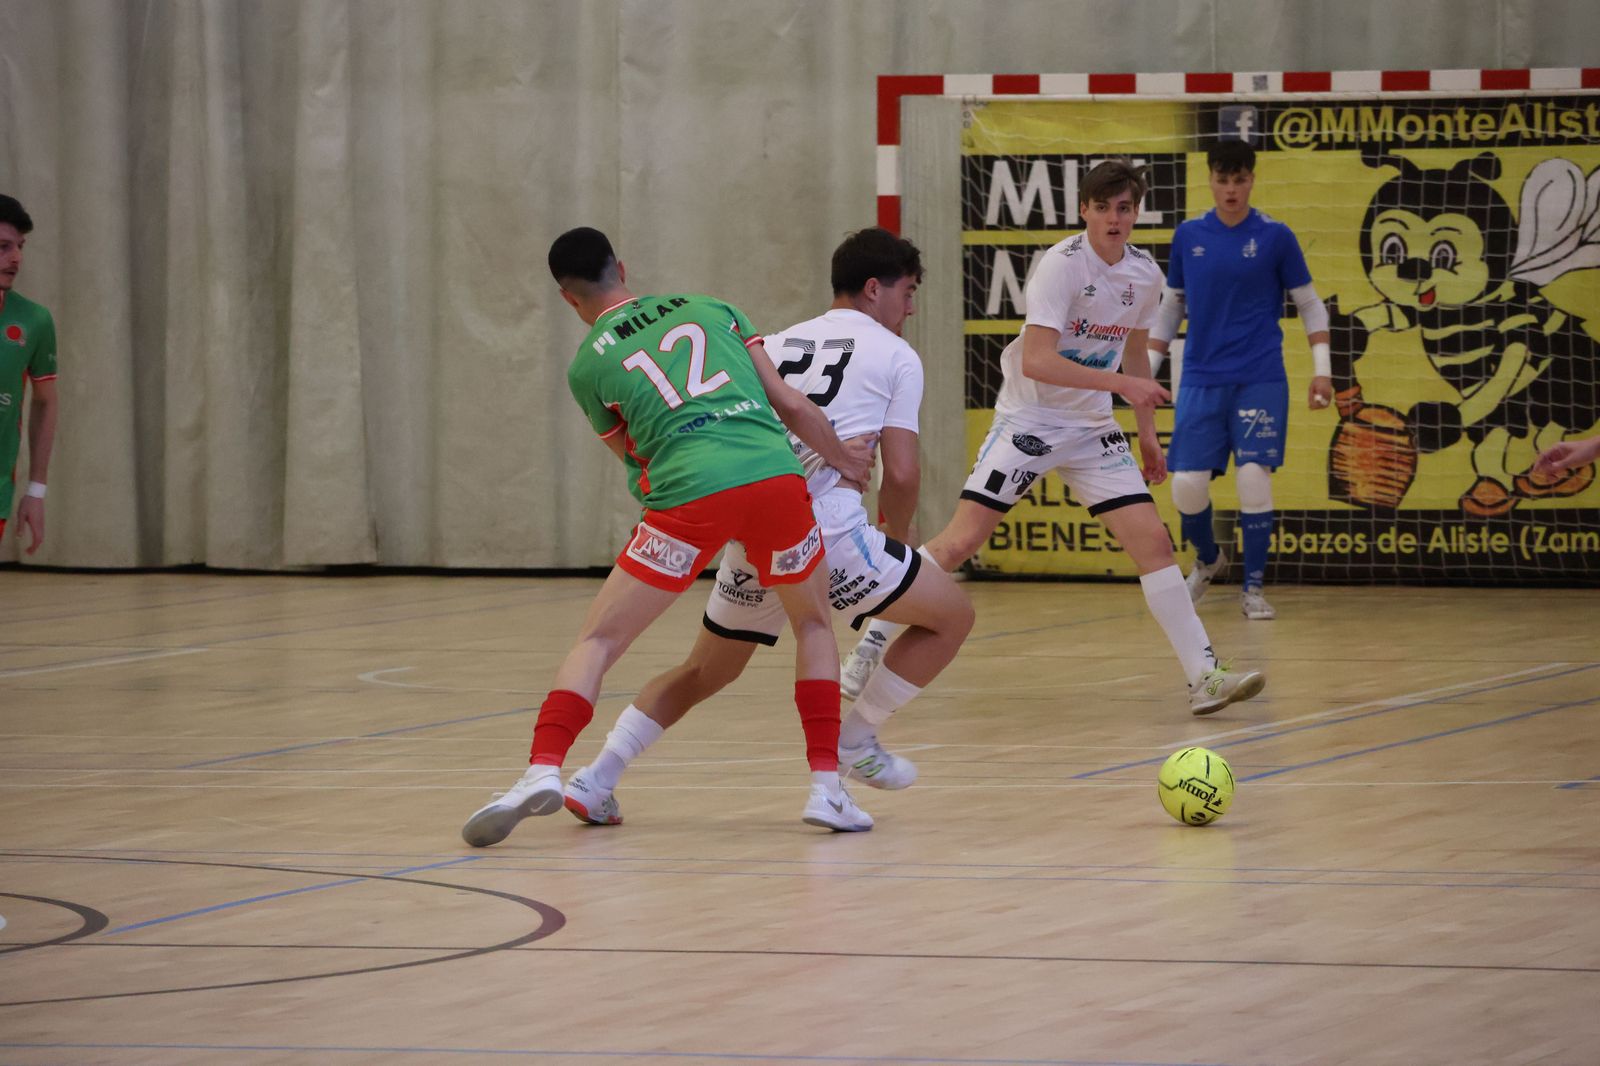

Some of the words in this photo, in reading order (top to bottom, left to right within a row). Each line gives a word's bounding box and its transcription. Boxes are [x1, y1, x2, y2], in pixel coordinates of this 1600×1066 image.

[986, 158, 1163, 225] MIL
[621, 321, 731, 411] 12
[778, 338, 855, 407] 23
[1233, 526, 1368, 553] Tbazos
[1377, 526, 1417, 553] de
[1427, 525, 1509, 554] Aliste
[719, 581, 763, 603] TORRES
